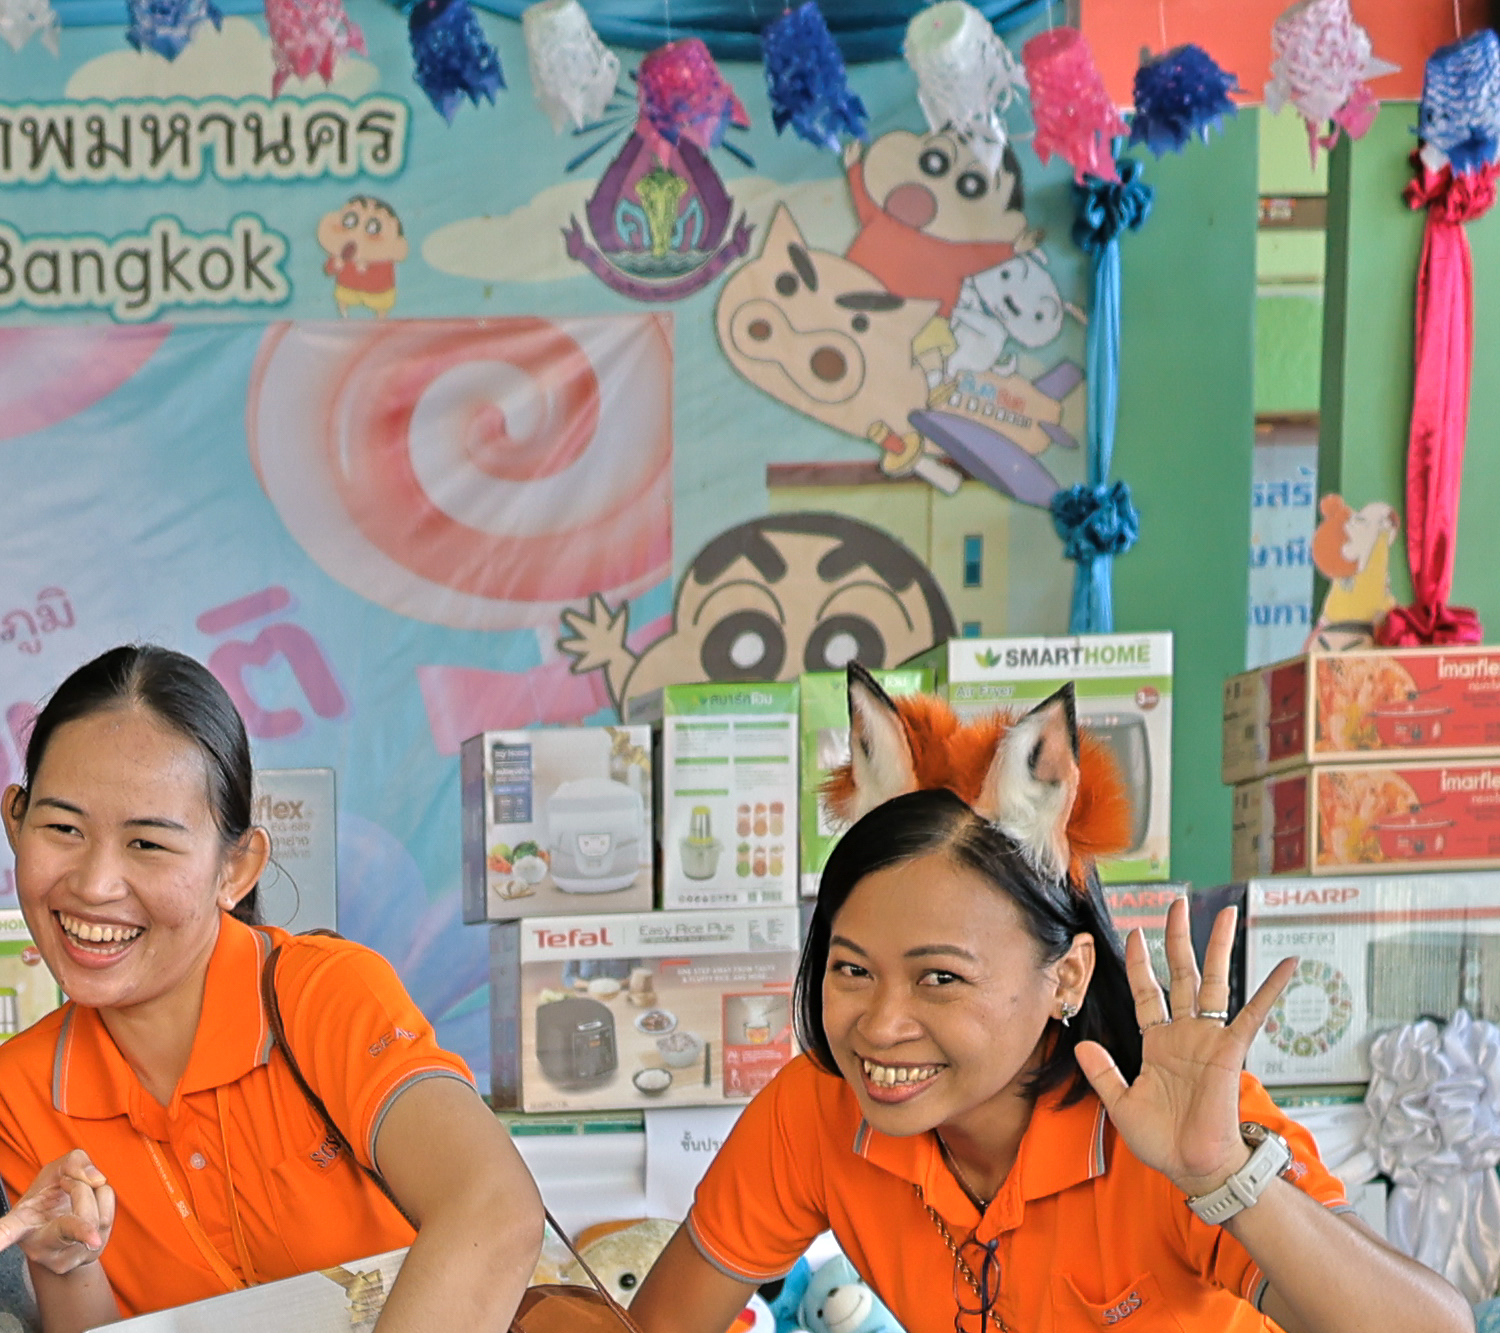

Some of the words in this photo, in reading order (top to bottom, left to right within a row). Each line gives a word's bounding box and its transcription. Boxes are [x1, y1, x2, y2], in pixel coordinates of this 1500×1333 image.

[1005, 644, 1151, 669] SMARTHOME
[956, 686, 975, 699] Air
[979, 683, 1015, 699] Fryer
[1264, 887, 1360, 906] SHARP
[532, 928, 614, 949] Tefal
[1102, 1290, 1143, 1325] SGS
